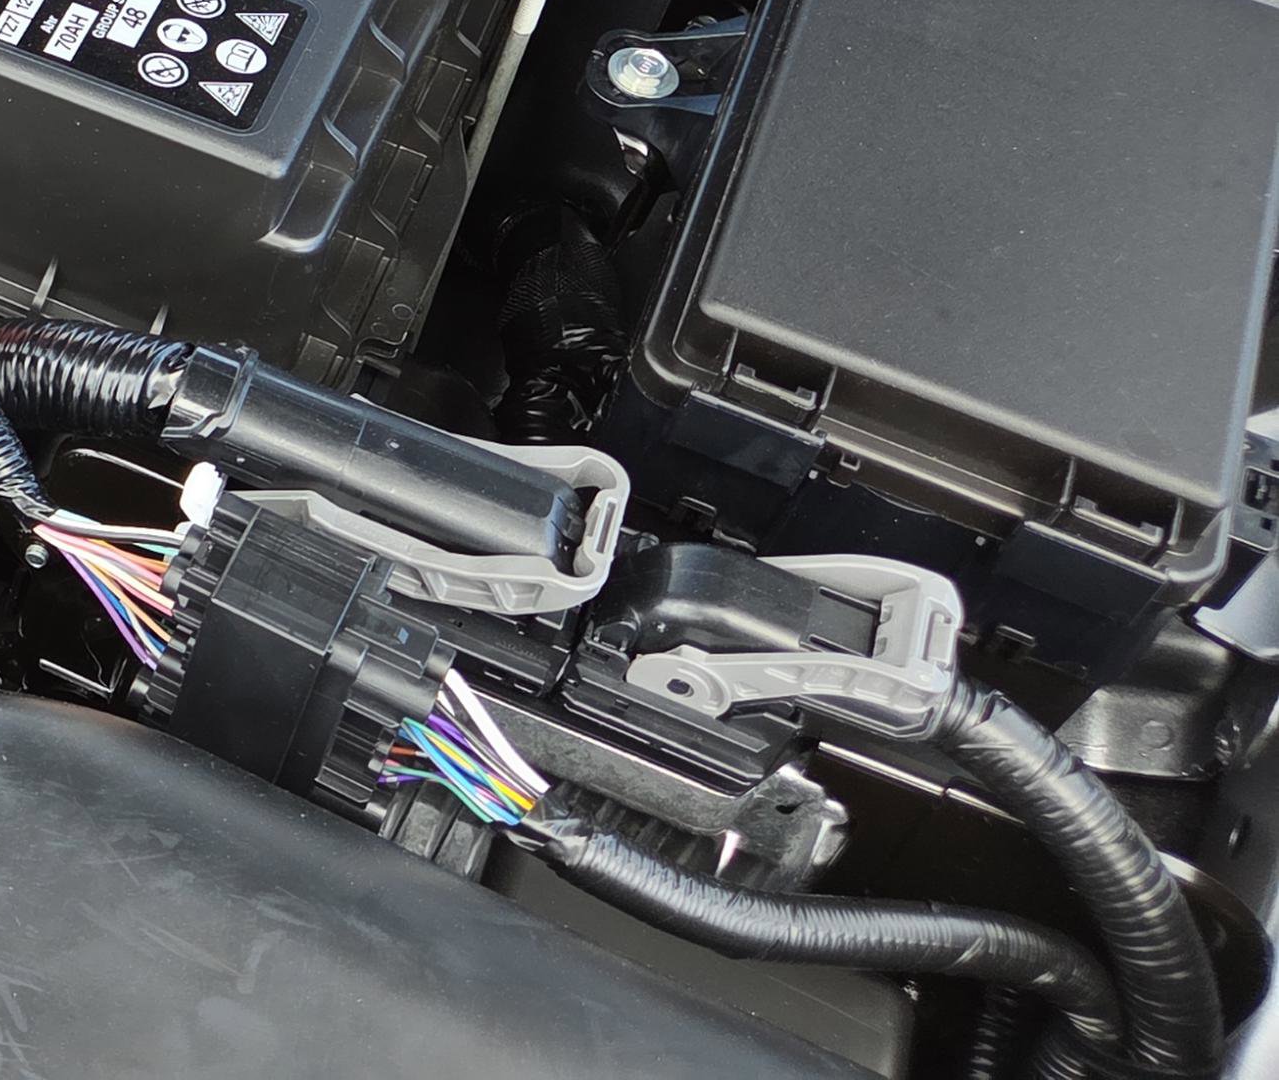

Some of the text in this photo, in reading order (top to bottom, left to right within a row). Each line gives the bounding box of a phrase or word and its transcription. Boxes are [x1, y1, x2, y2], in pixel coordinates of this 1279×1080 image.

[54, 13, 89, 51] 70AH
[92, 3, 120, 39] GROUP
[121, 7, 147, 29] 48
